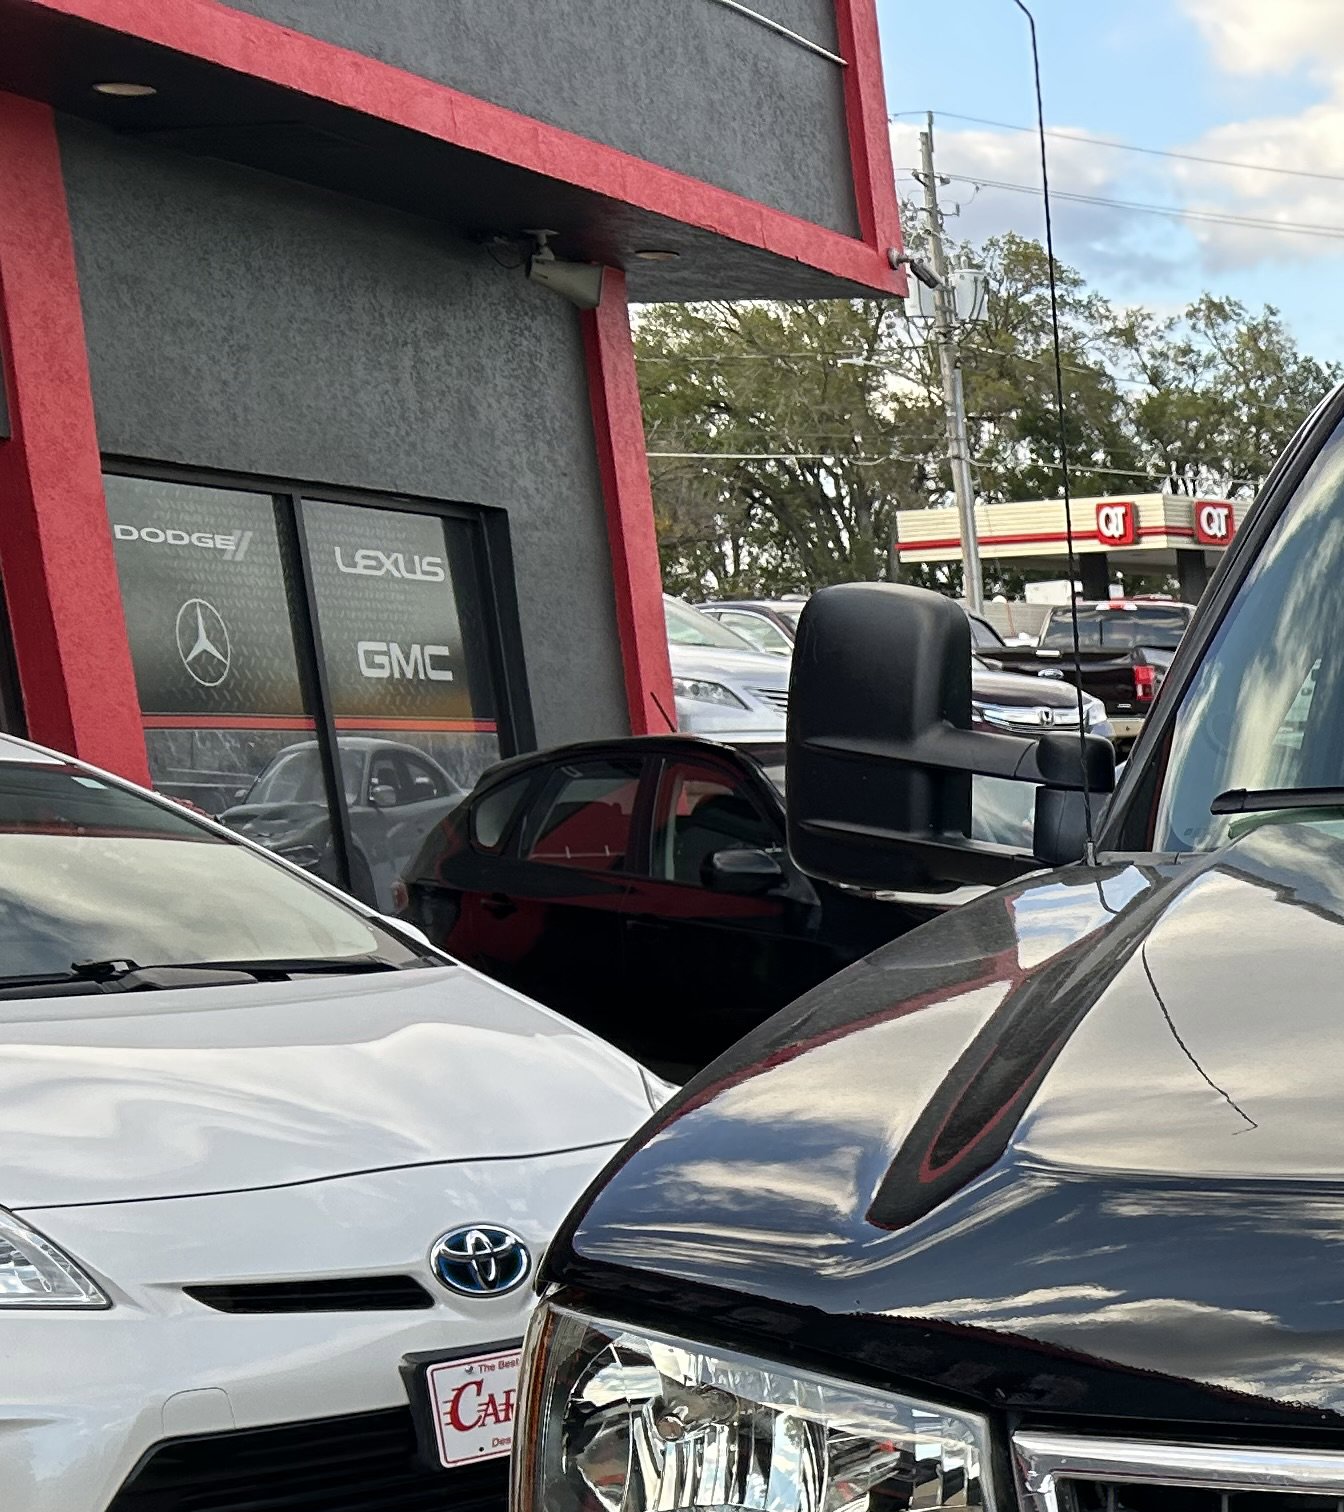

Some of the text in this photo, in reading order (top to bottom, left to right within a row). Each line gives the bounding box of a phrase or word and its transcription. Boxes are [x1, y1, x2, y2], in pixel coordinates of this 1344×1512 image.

[114, 524, 237, 549] DODGE
[1099, 506, 1126, 538] QT
[1200, 506, 1229, 538] QT
[334, 546, 446, 582] LEXUS
[357, 640, 454, 681] GMC
[479, 1363, 496, 1374] The
